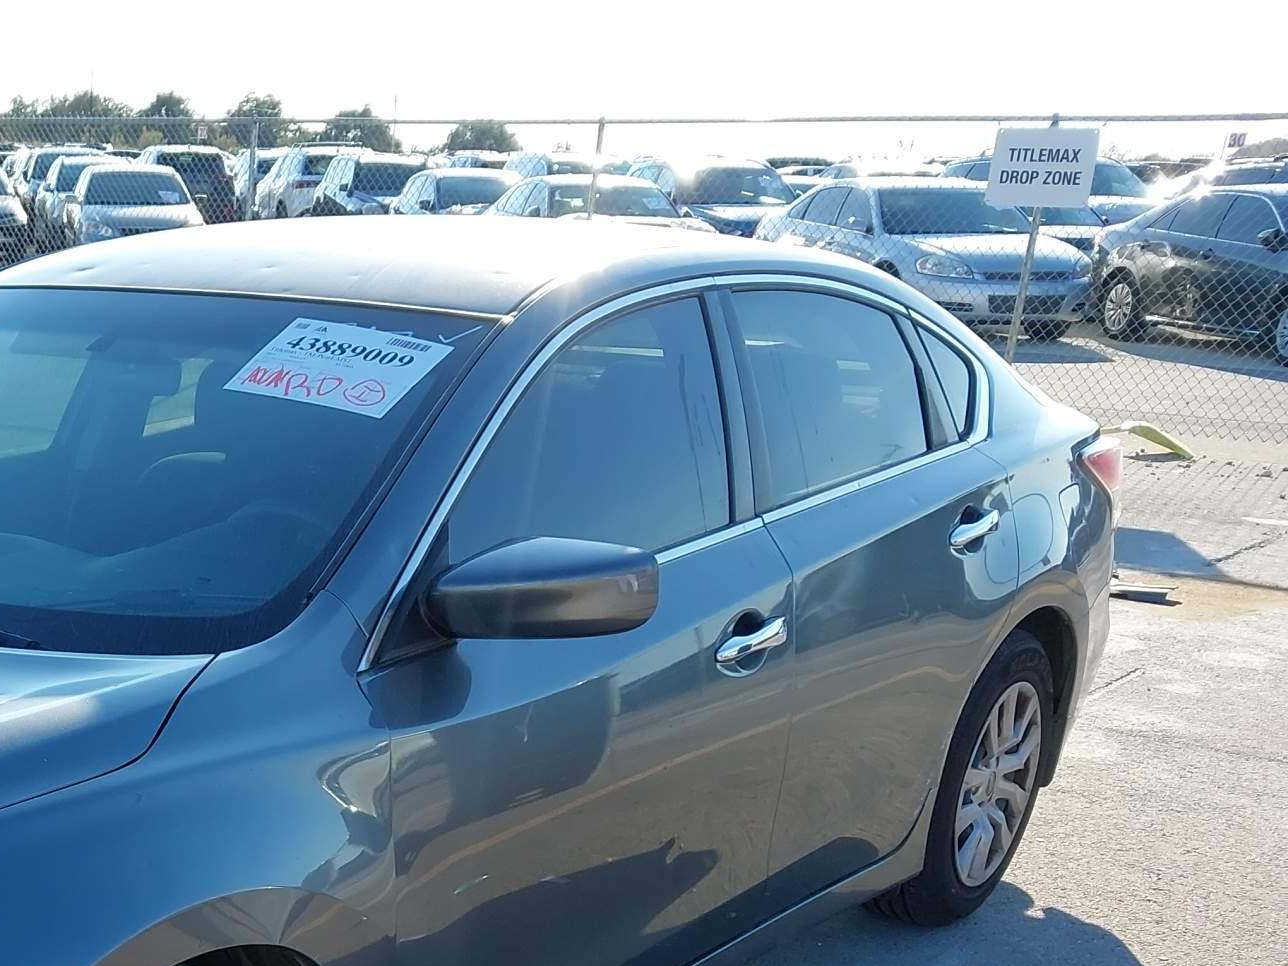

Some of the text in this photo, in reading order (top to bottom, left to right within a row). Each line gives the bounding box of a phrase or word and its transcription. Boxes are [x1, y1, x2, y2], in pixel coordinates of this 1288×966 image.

[1227, 133, 1247, 148] 30
[1009, 147, 1082, 163] TITLEMAX
[999, 169, 1082, 186] DROP ZONE
[286, 335, 415, 368] 43889009
